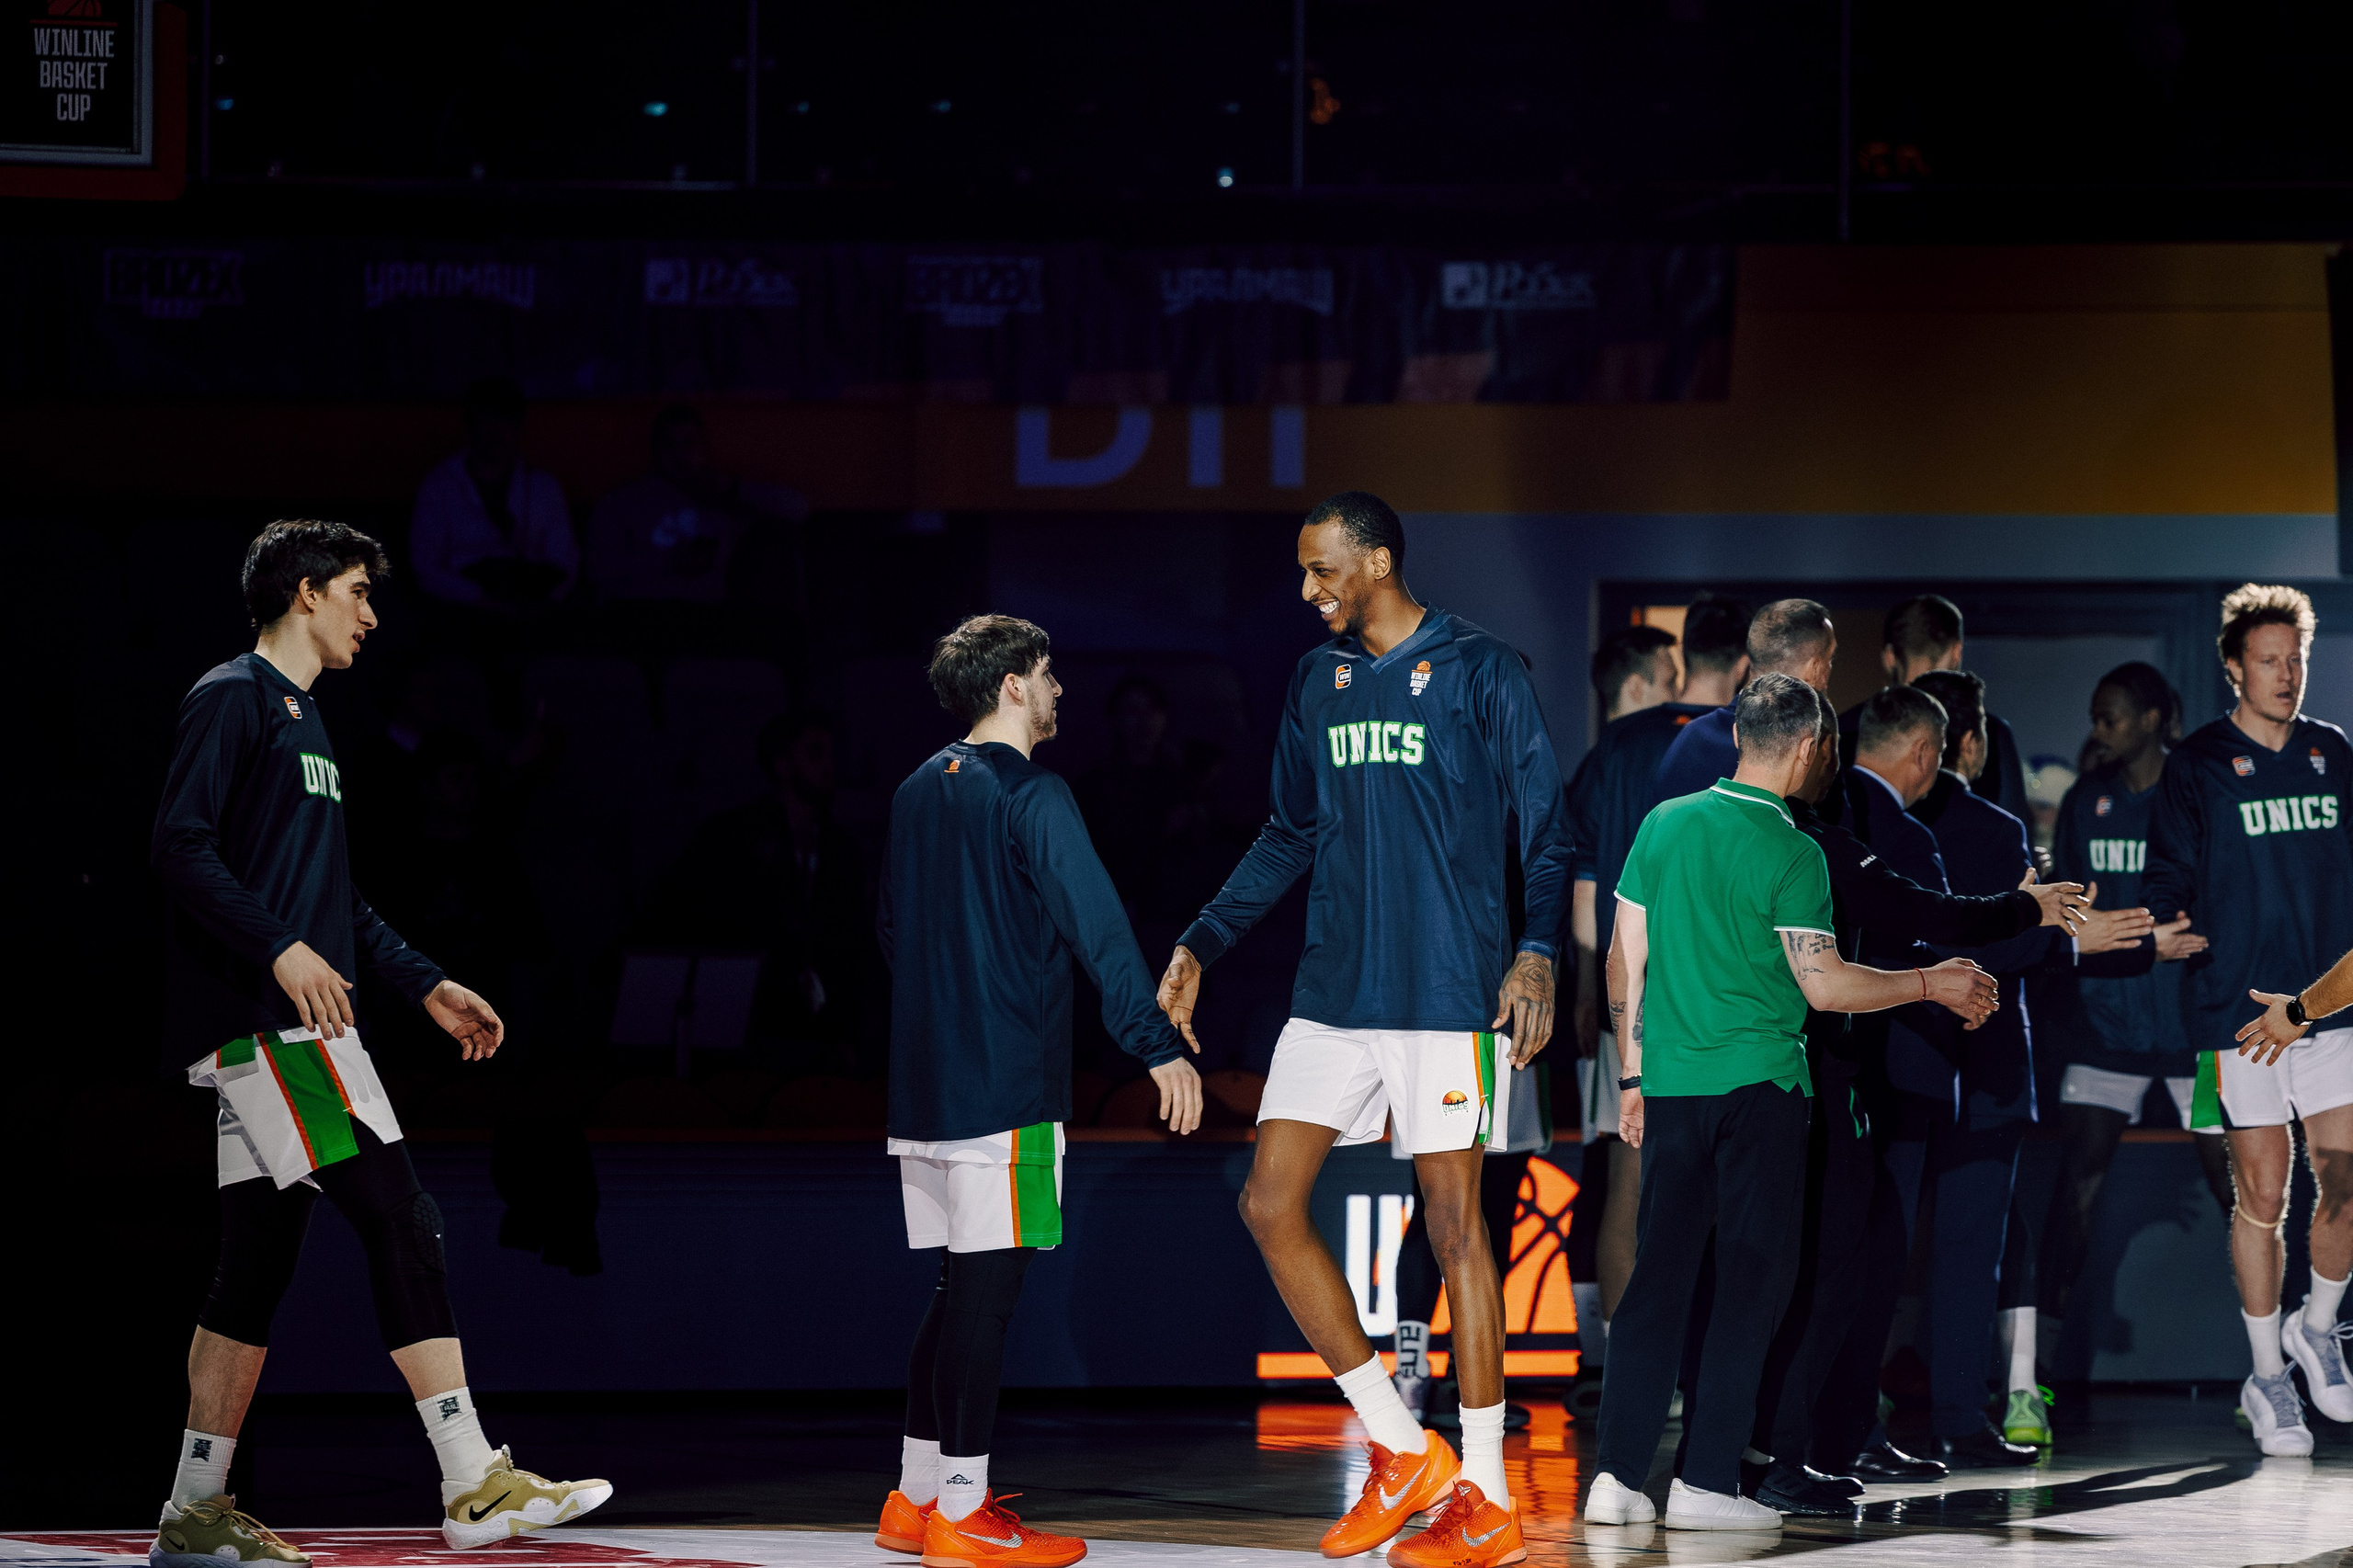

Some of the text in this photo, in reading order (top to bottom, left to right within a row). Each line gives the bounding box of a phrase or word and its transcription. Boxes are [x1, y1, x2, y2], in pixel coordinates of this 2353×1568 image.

[34, 28, 115, 58] WINLINE
[40, 60, 108, 90] BASKET
[56, 93, 91, 121] CUP
[364, 262, 536, 311] УРАЛМАШ
[1327, 720, 1426, 768] UNICS
[299, 752, 342, 803] UNIC
[2238, 793, 2339, 837] UNICS
[2088, 837, 2147, 873] UNI
[437, 1395, 462, 1421] PEA
[946, 1477, 975, 1485] PEAK
